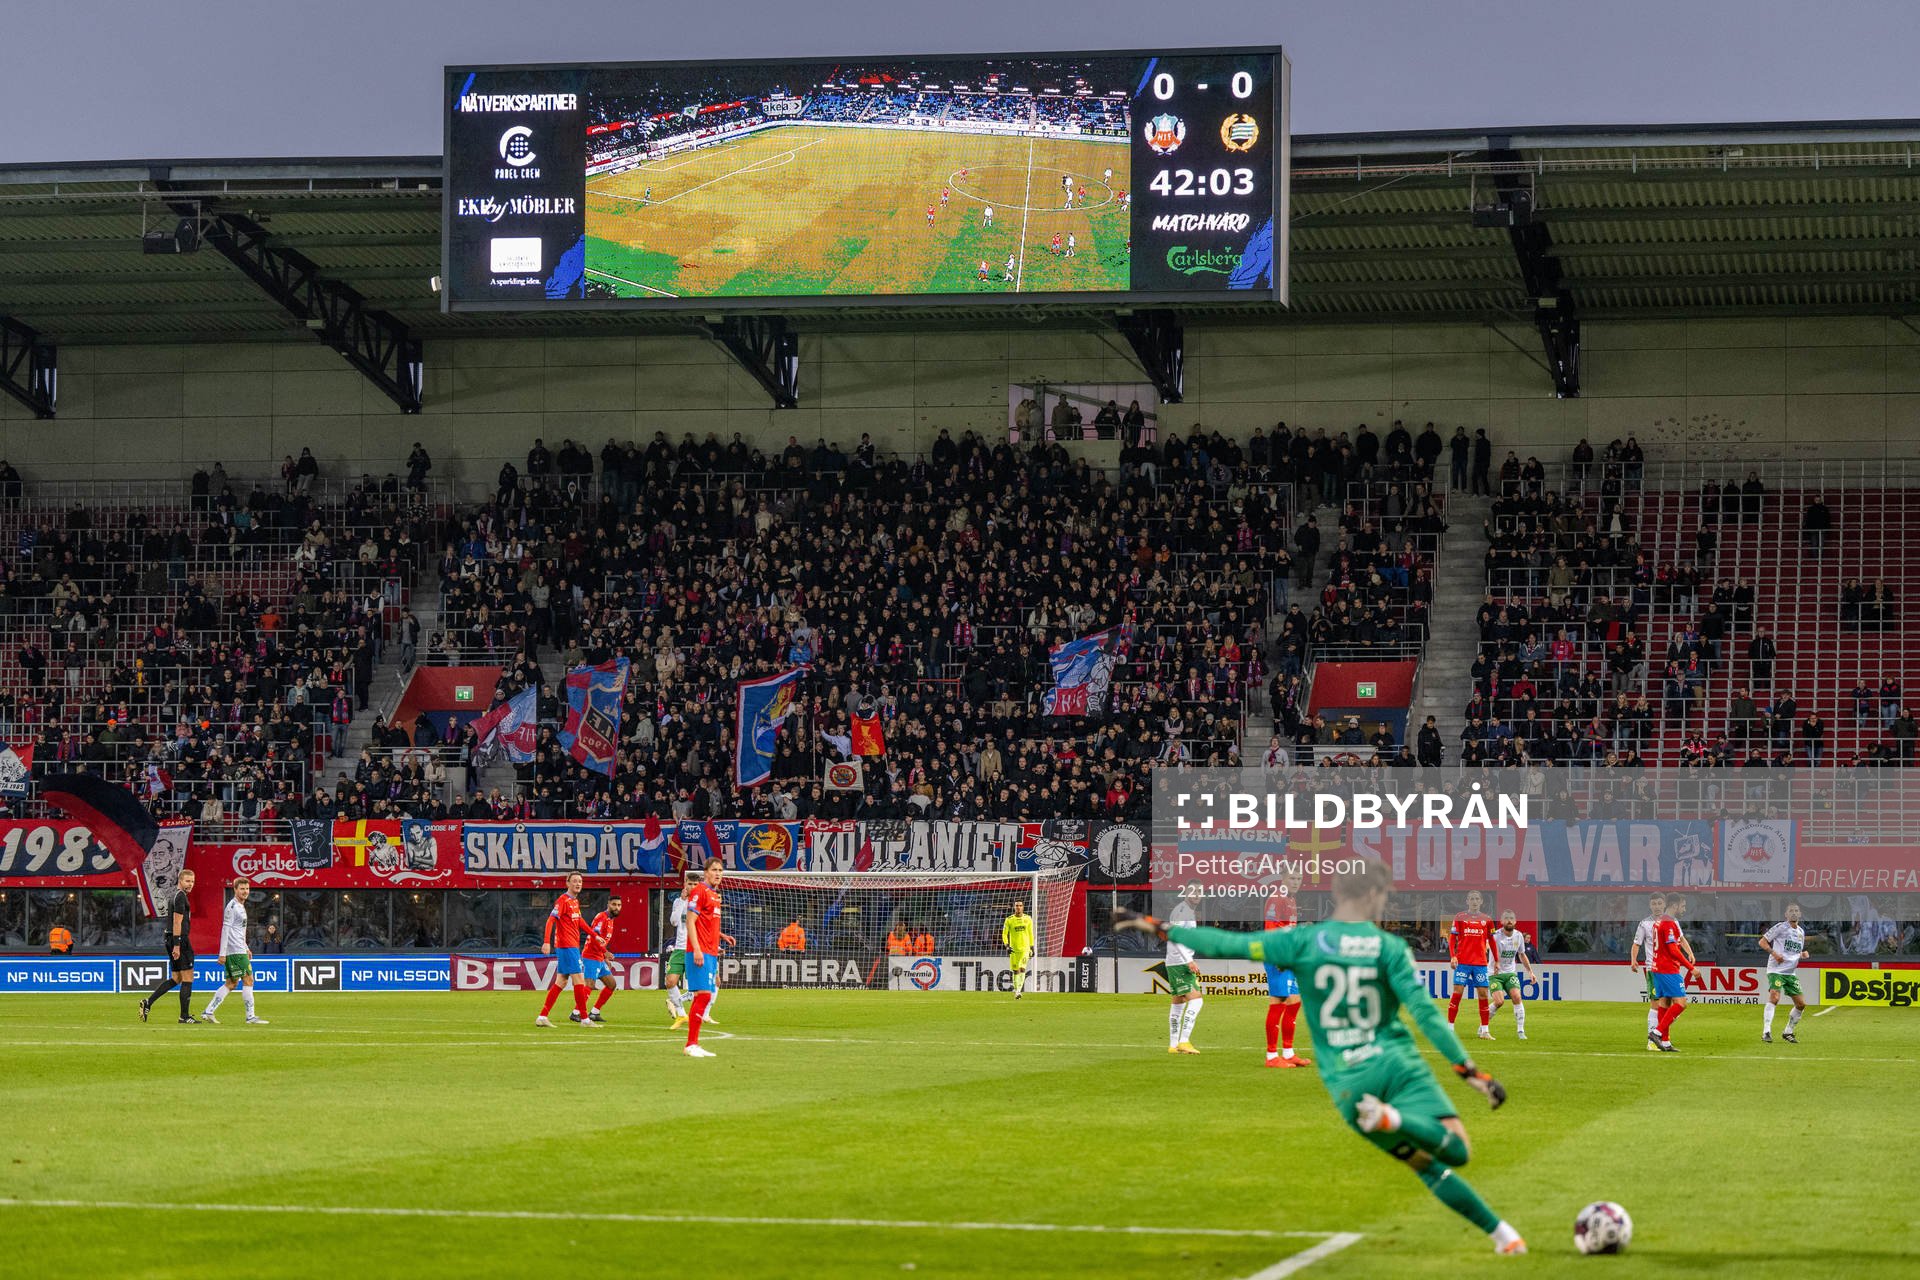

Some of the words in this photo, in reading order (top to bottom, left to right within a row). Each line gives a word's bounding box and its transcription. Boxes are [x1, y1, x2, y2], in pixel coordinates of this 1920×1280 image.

[1153, 73, 1175, 100] 0
[1231, 71, 1253, 99] 0
[461, 93, 577, 112] NÄTVERKSPARTNER
[1149, 168, 1254, 196] 42:03
[509, 195, 575, 214] MÖBLER
[1152, 212, 1250, 232] MATCHVÄRD
[1167, 246, 1243, 270] Carlsberg
[805, 820, 854, 831] ACAB
[1108, 823, 1146, 839] POTENTIALS
[1180, 828, 1283, 843] FALANGEN
[1353, 822, 1549, 882] STOPPA
[1566, 823, 1661, 883] VAR
[1098, 863, 1142, 879] HELSNGBORG
[7, 971, 29, 983] NP
[32, 971, 104, 983] NILSSON
[127, 966, 163, 986] NP
[300, 966, 336, 985] NP
[351, 970, 373, 982] NP
[378, 970, 450, 982] NILSSON
[722, 958, 863, 983] PTIMERA
[903, 969, 932, 979] Thermia
[951, 960, 1076, 992] Thermi
[1081, 962, 1090, 989] SELECT
[1196, 972, 1246, 983] önssons
[1249, 971, 1270, 984] Plå
[1206, 986, 1270, 996] Helsingbo
[1314, 963, 1382, 1030] 25
